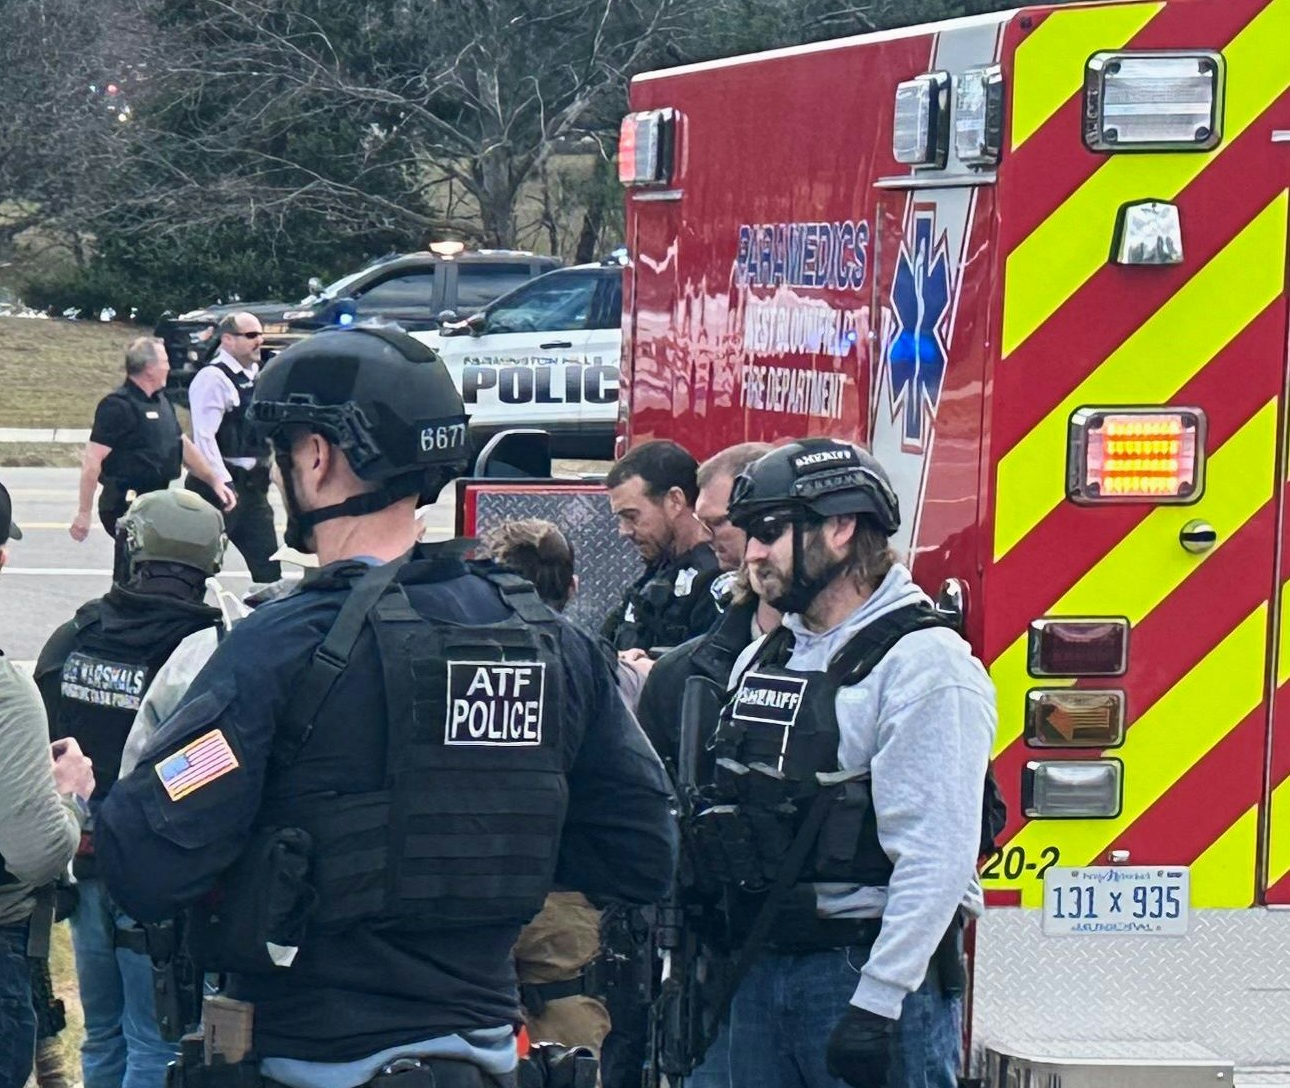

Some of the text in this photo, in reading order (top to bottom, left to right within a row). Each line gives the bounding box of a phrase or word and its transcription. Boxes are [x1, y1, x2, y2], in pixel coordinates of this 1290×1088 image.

[737, 219, 869, 291] PARAMEDICS
[462, 366, 619, 404] POLIC
[466, 666, 532, 697] ATF
[451, 699, 539, 740] POLICE
[981, 846, 1061, 880] 20-2
[1052, 887, 1099, 919] 131
[1132, 886, 1181, 919] 935
